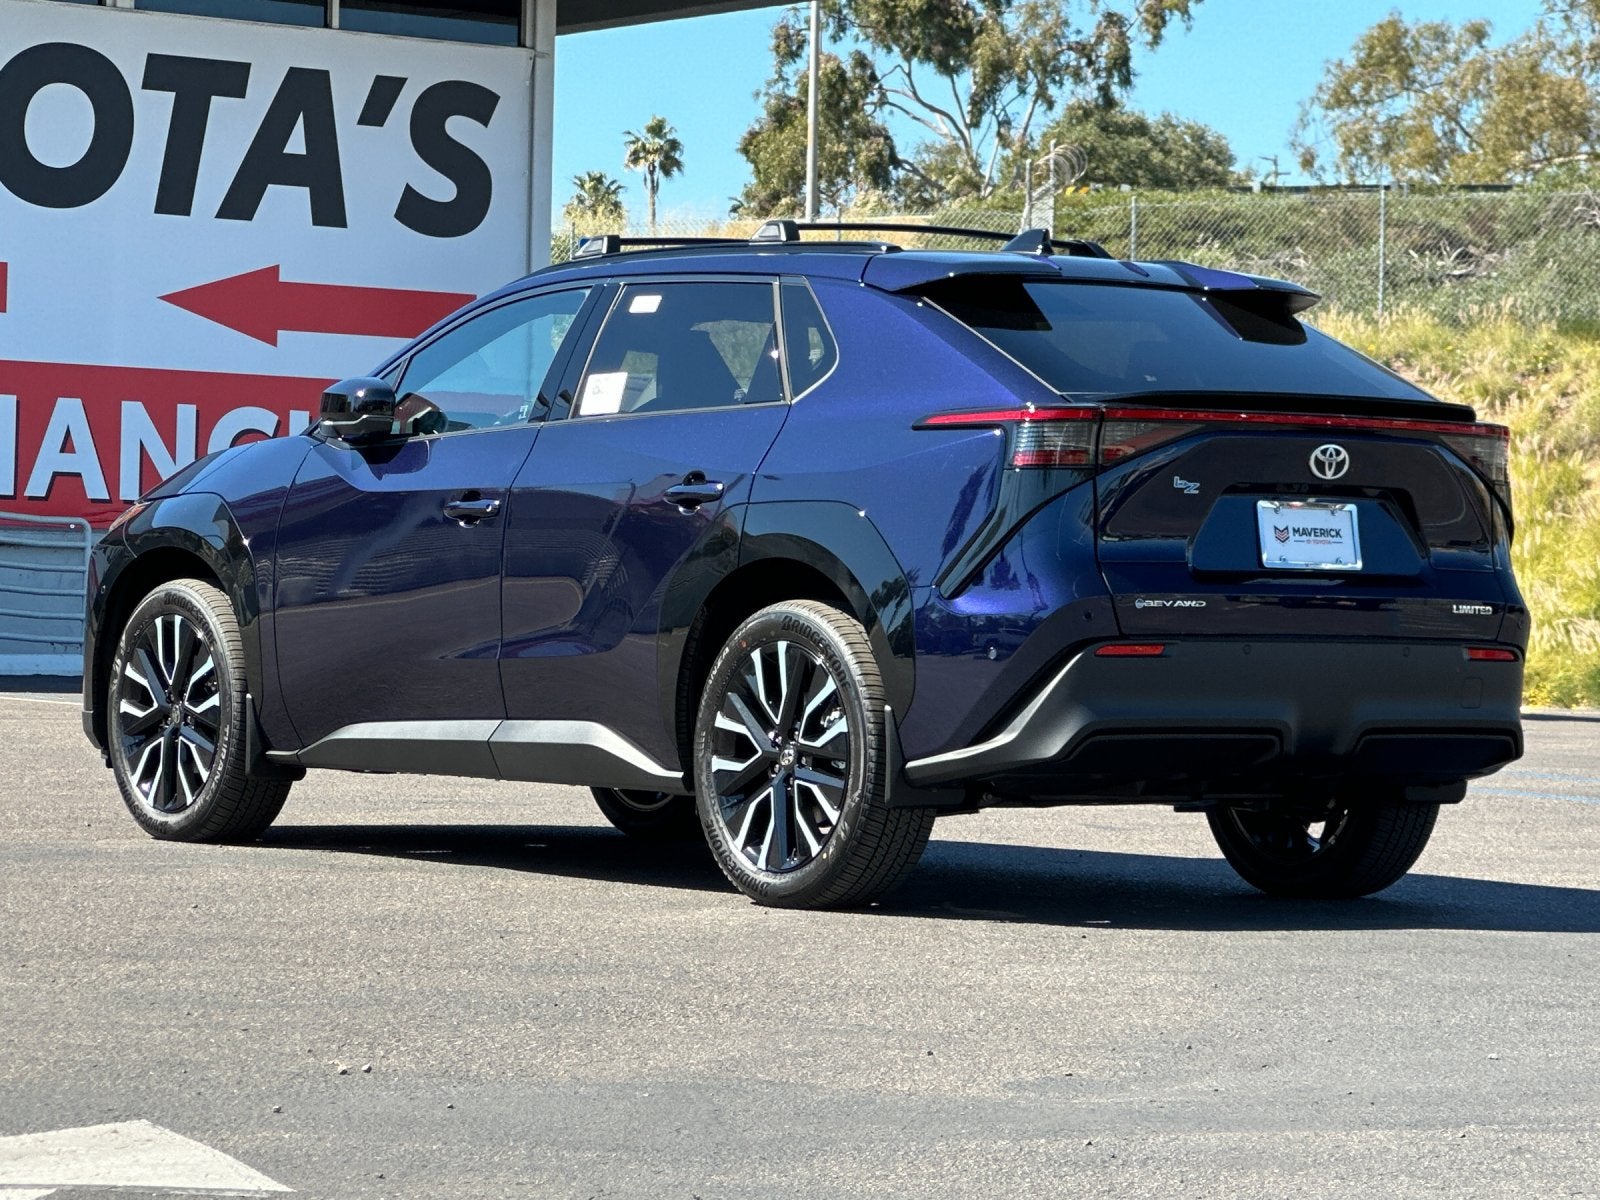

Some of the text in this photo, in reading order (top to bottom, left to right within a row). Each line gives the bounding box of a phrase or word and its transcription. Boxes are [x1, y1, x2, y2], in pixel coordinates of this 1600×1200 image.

[1292, 526, 1343, 539] MAVERICK
[1173, 600, 1207, 608] AWD
[1452, 604, 1493, 615] LIMITED
[781, 614, 852, 694] BRIDGESTONE
[704, 818, 771, 898] BRIDGESTONE
